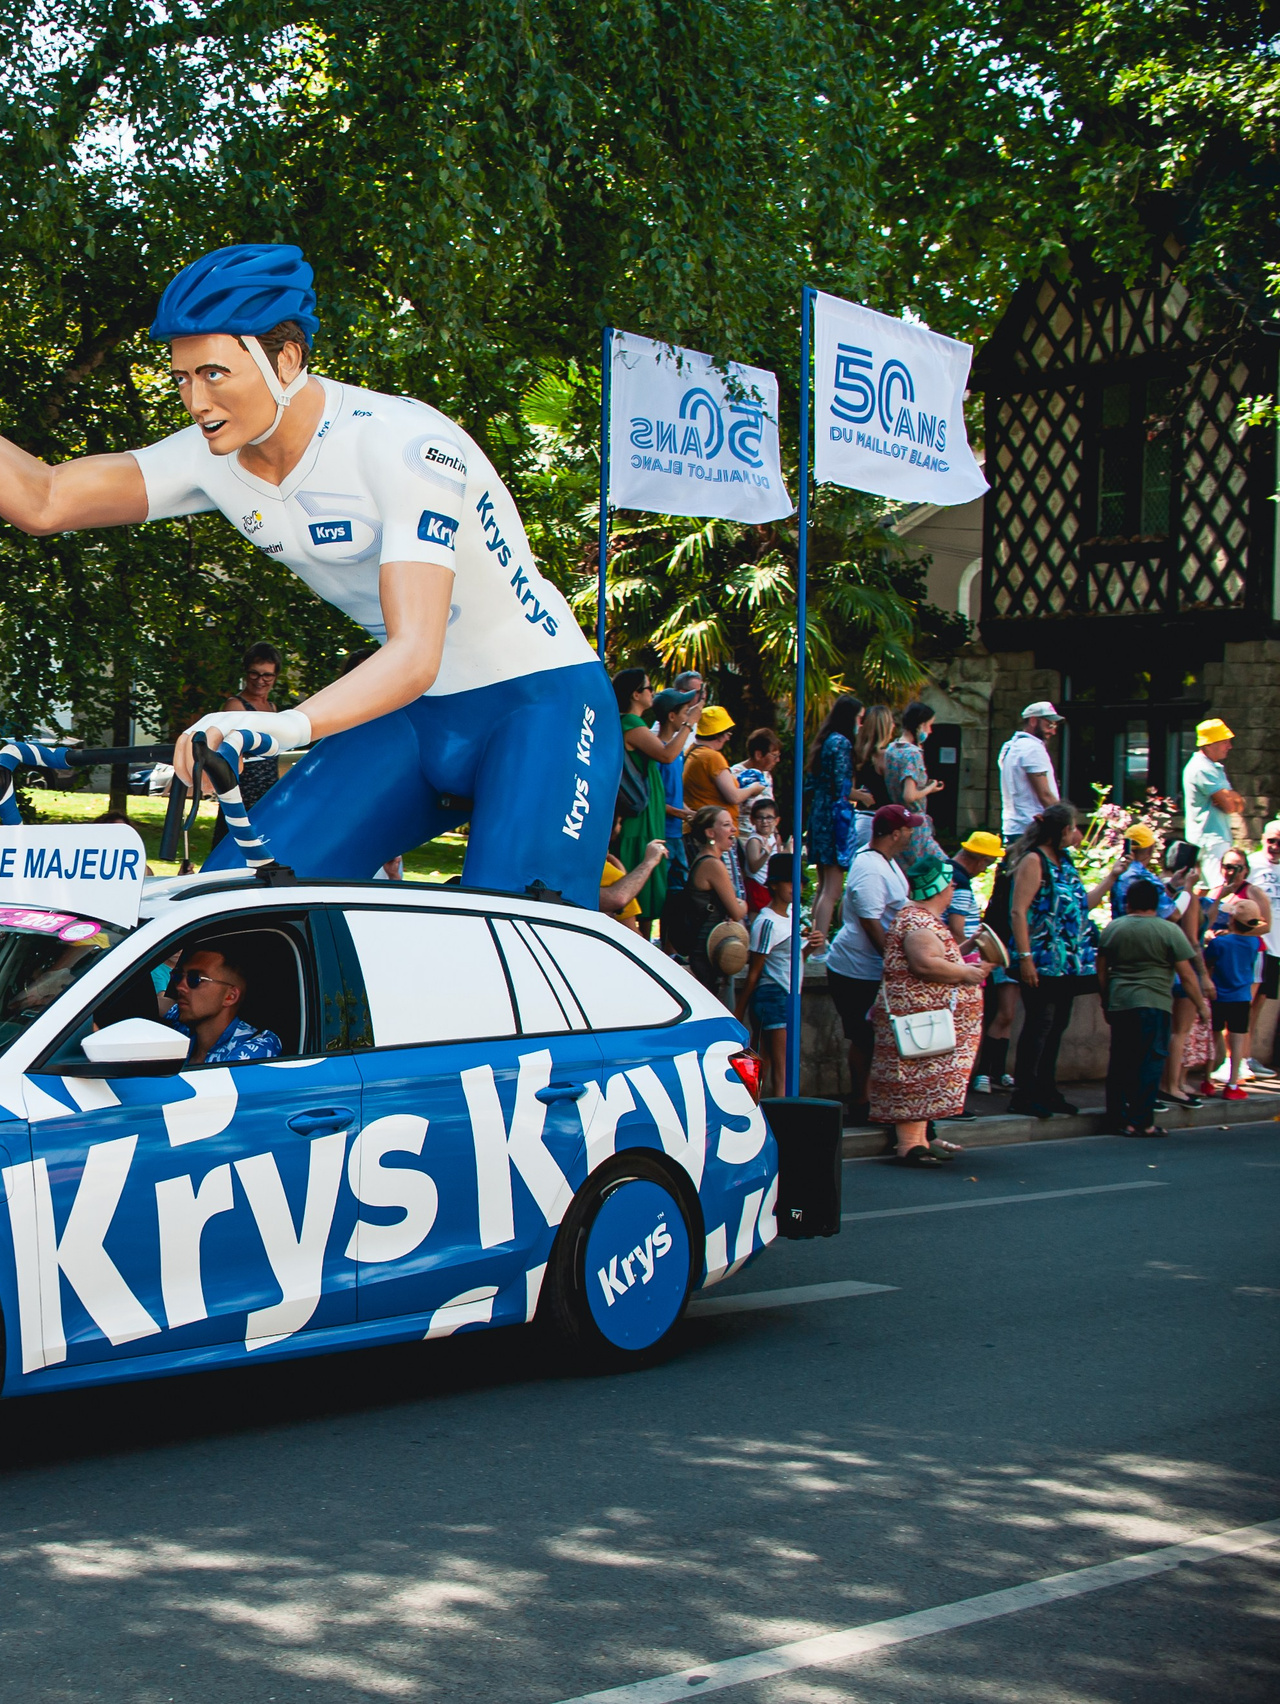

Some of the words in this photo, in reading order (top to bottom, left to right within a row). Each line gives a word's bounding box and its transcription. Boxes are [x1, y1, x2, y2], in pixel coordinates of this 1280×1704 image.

[830, 343, 915, 434] 50
[894, 406, 948, 452] ANS
[830, 426, 854, 443] DU
[856, 431, 909, 461] MAILLOT
[909, 449, 950, 473] BLANC
[316, 526, 346, 539] Krys
[426, 517, 457, 549] Kry
[476, 491, 512, 567] Krys
[510, 565, 559, 637] Krys
[562, 777, 589, 840] Krys
[576, 705, 595, 766] Krys
[23, 848, 140, 881] MAJEUR
[1, 1131, 439, 1375] Krys
[597, 1222, 673, 1307] Krys
